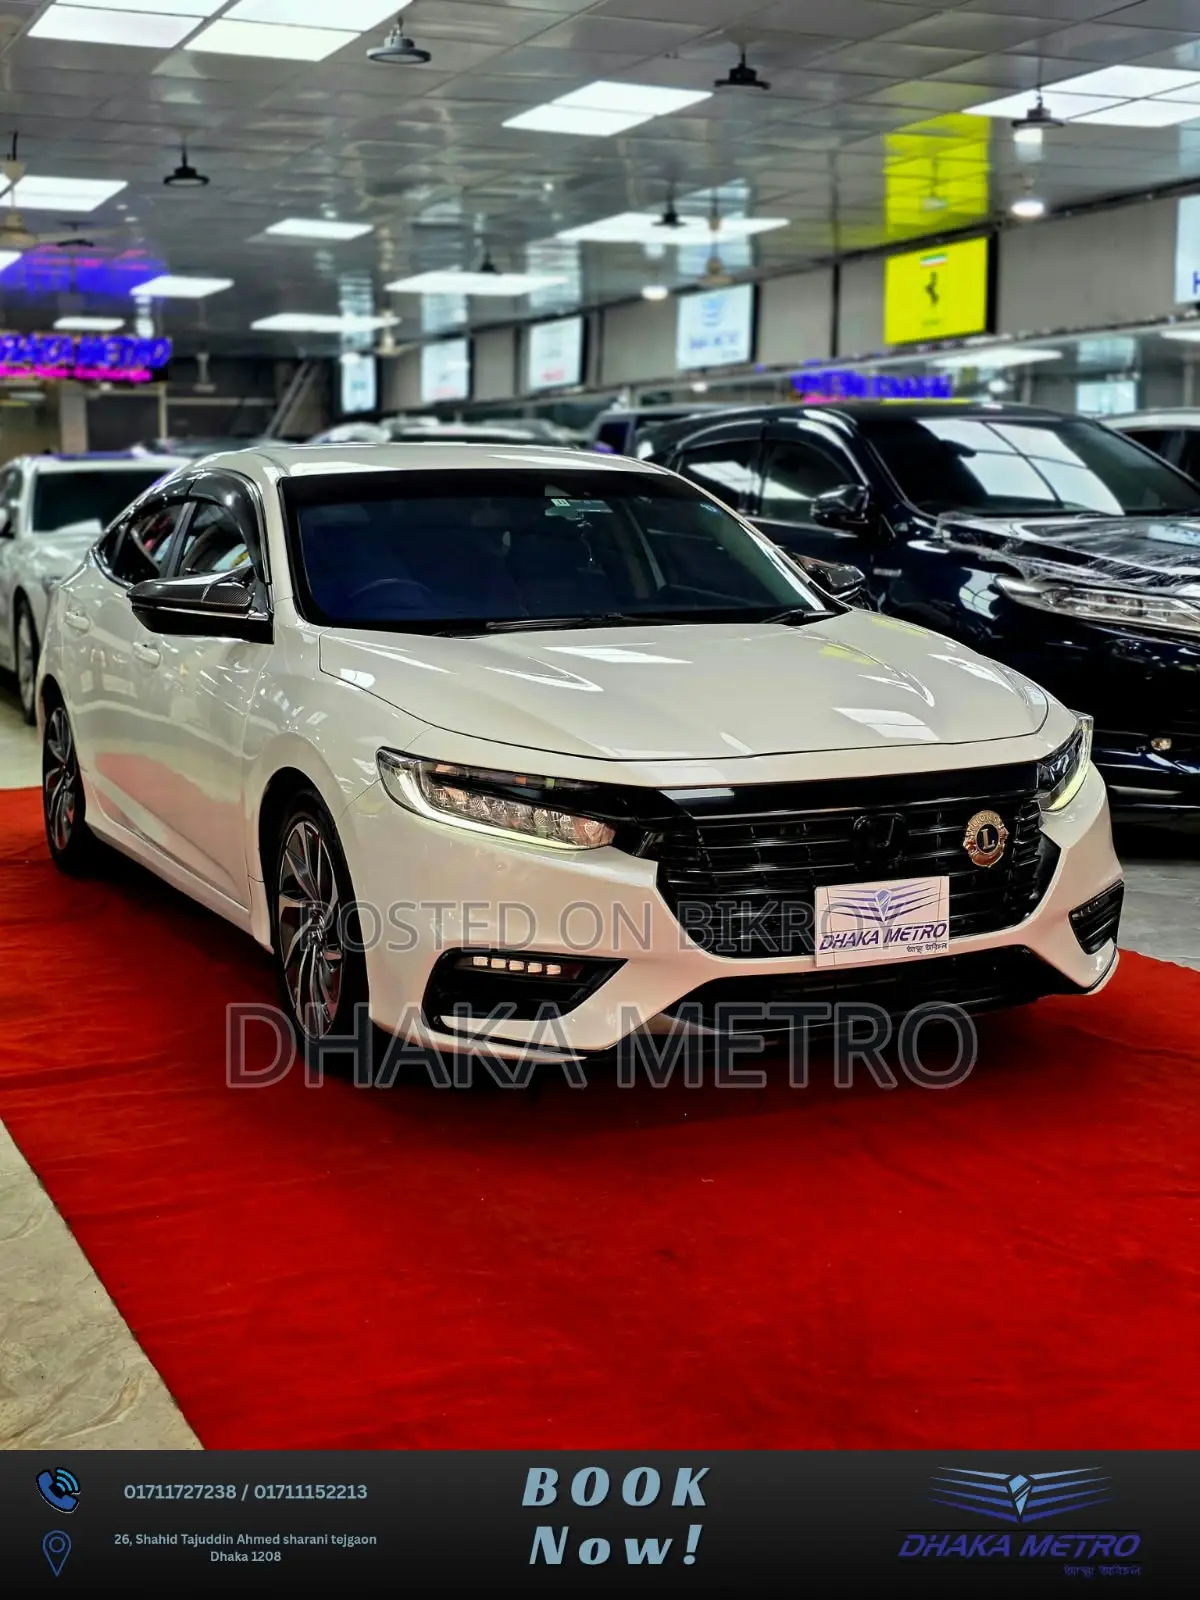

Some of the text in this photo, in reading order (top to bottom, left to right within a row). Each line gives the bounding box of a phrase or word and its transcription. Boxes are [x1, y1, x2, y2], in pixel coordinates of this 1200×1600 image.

[980, 828, 996, 850] L
[818, 922, 948, 951] DHAKA METRO
